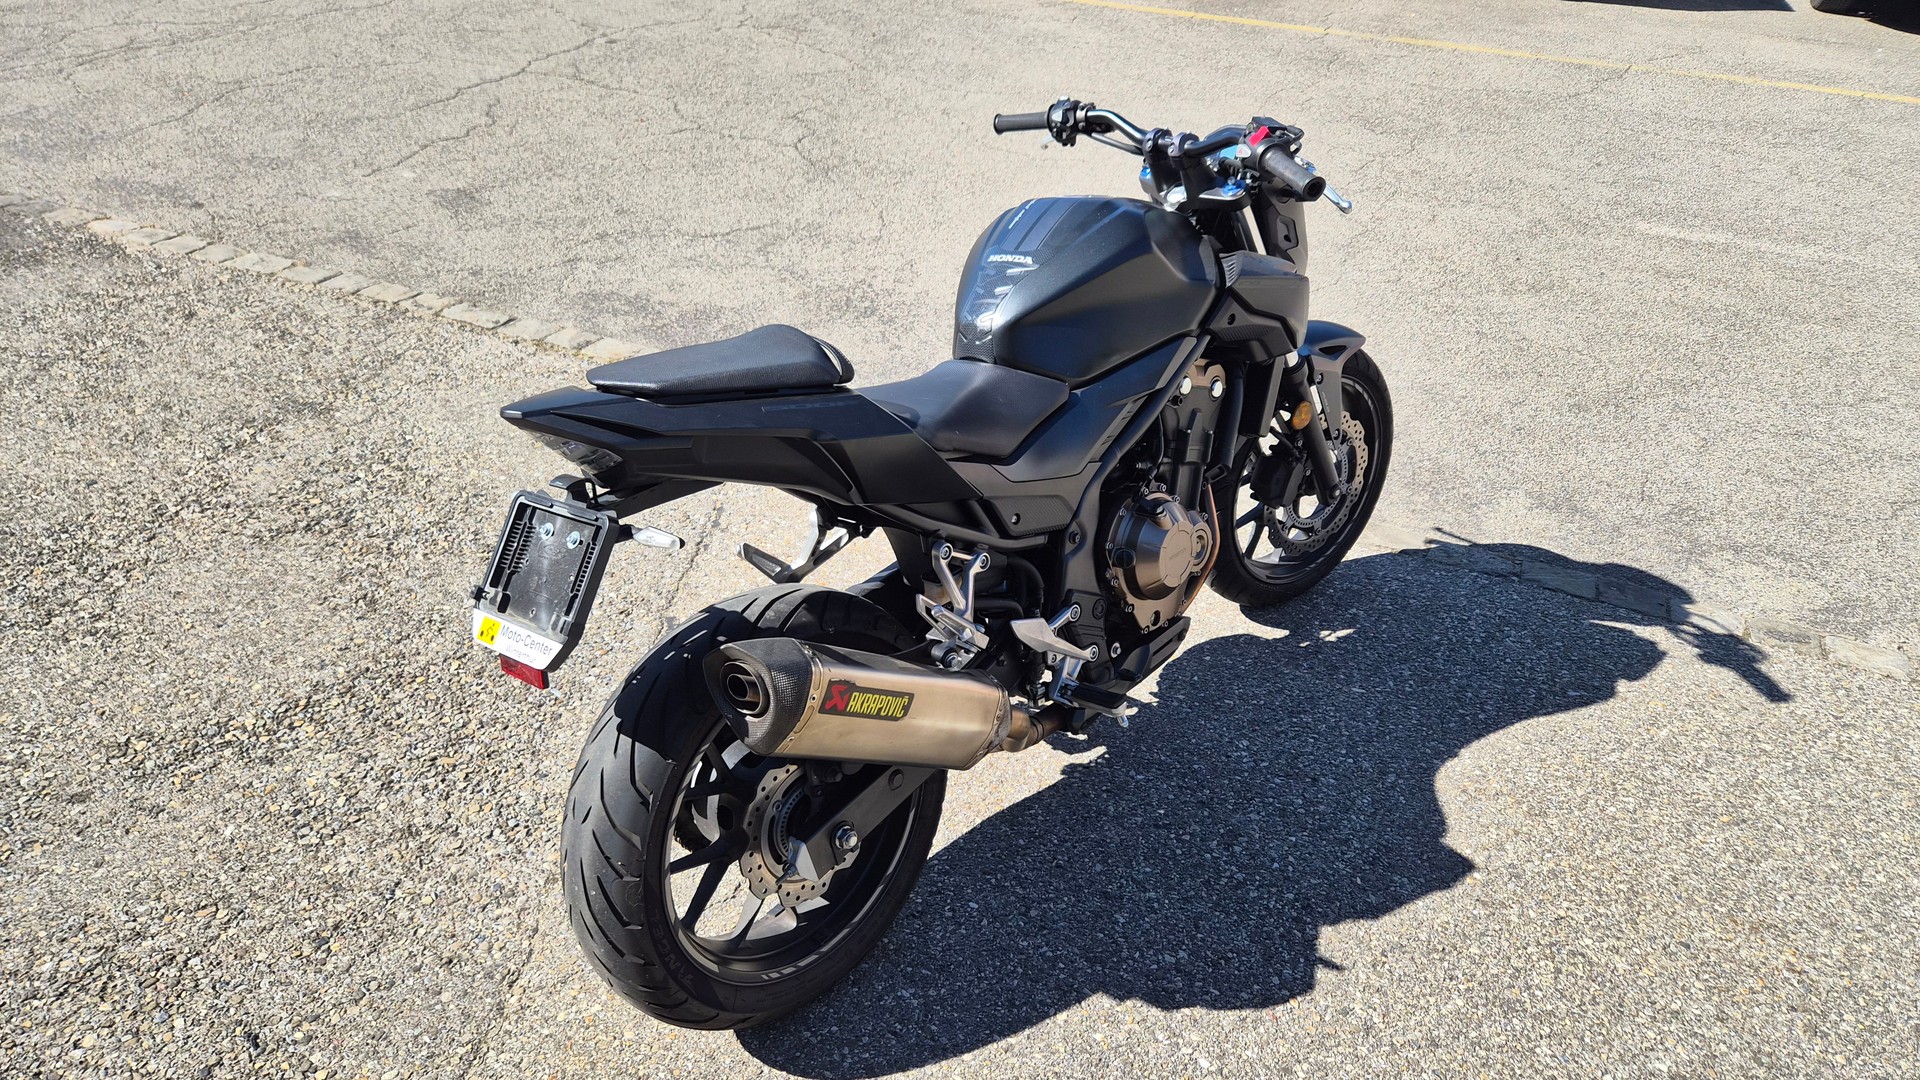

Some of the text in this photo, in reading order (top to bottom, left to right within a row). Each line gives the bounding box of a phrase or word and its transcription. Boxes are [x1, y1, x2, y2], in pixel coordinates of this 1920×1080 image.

[987, 254, 1034, 264] HONDA
[501, 624, 554, 656] Moto-Center
[846, 691, 909, 718] AKRAPOVIČ
